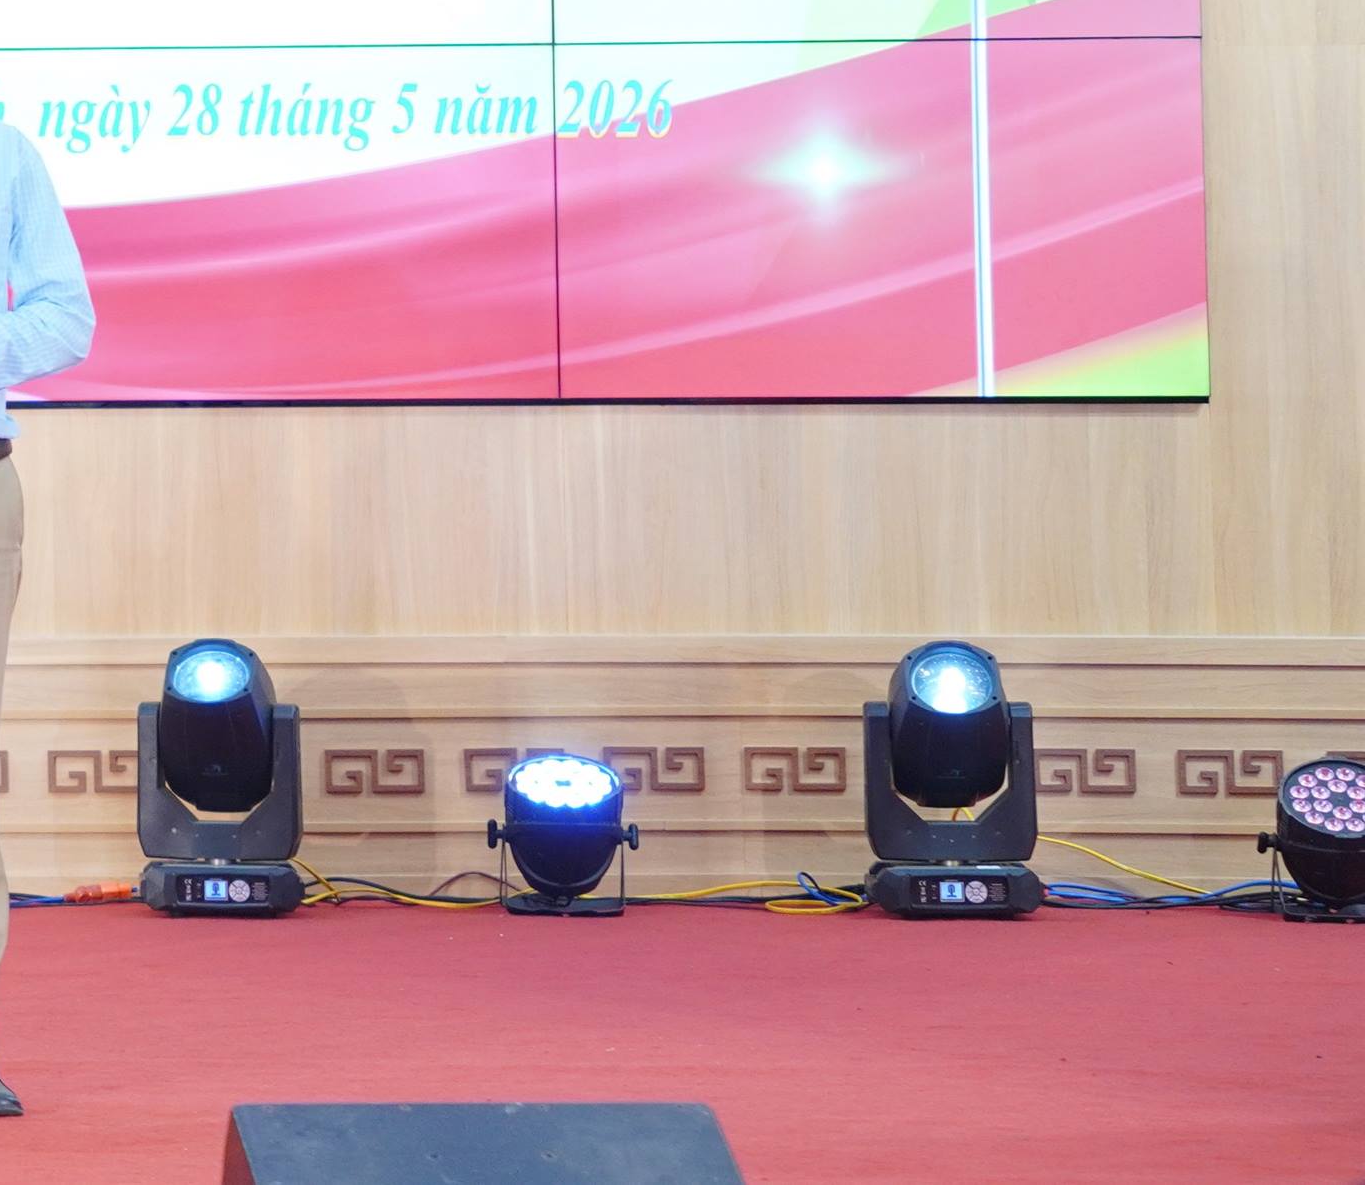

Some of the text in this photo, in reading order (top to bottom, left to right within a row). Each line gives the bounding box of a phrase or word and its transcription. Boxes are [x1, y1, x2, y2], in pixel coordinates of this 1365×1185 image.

[37, 83, 152, 154] ngày
[167, 83, 223, 137] 28
[237, 81, 376, 153] tháng
[391, 82, 419, 135] 5
[433, 82, 539, 136] năm
[555, 78, 674, 139] 2026
